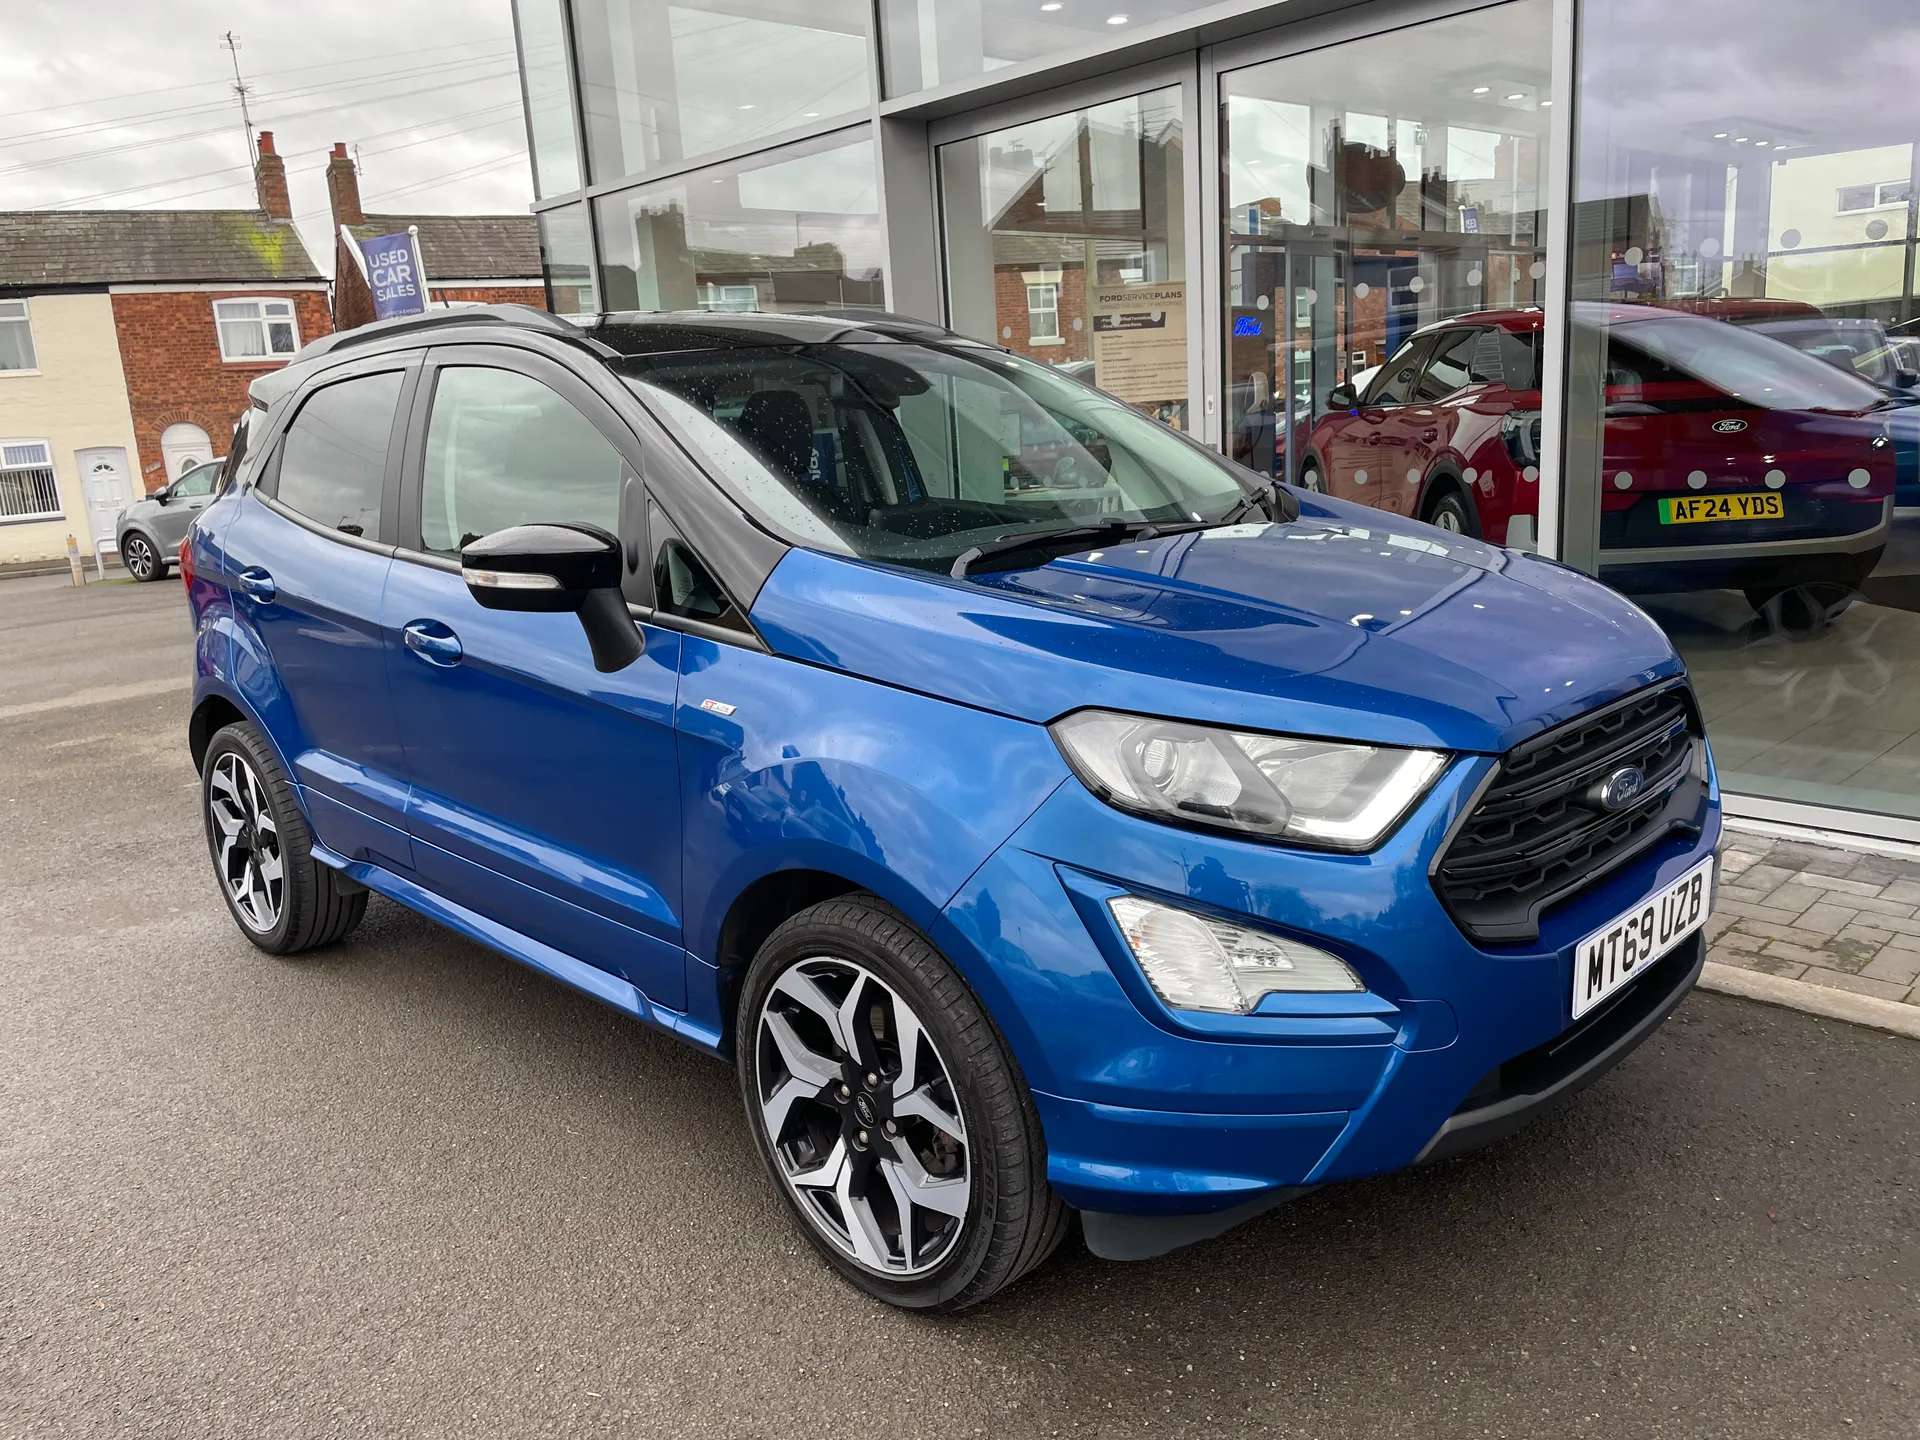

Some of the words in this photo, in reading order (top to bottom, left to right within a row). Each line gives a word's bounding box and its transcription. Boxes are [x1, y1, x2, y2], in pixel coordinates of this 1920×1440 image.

[368, 249, 409, 268] USED
[372, 264, 413, 288] CAR
[376, 284, 416, 302] SALES
[1675, 497, 1732, 520] AF24
[1737, 496, 1779, 516] YDS
[1586, 906, 1655, 1001] MT69
[1660, 872, 1703, 945] UZB
